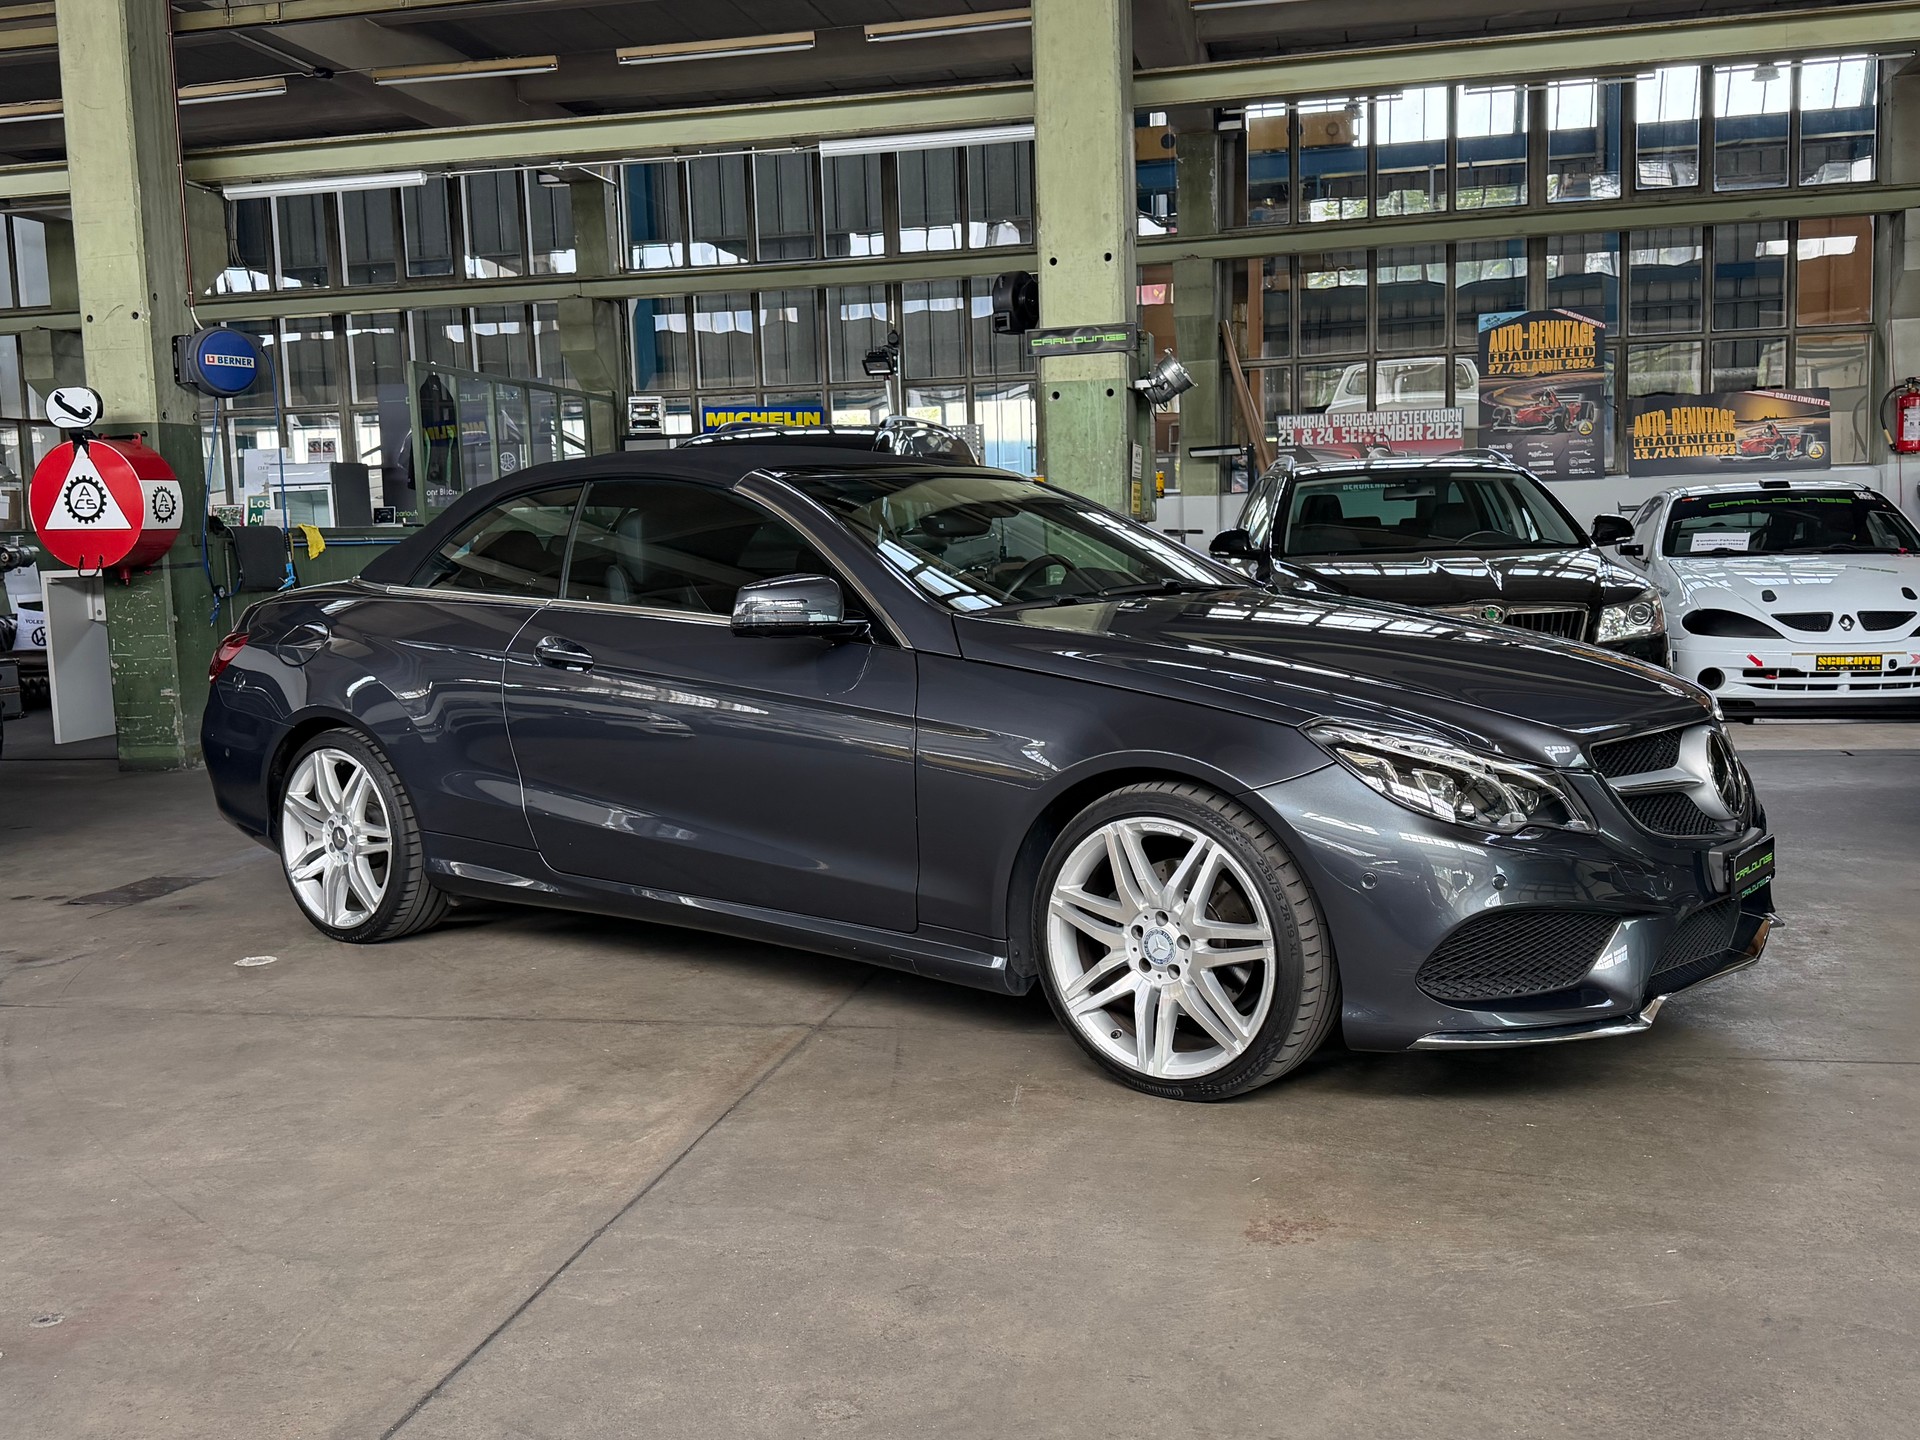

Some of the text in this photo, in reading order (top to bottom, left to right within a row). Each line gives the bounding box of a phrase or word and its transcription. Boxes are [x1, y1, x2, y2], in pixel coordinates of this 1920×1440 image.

[1031, 333, 1127, 347] CARLOUNGE
[1488, 320, 1596, 353] AUTO-RENNTAGE
[217, 356, 253, 367] BERNER
[1489, 347, 1594, 363] FRAUENFELD
[1565, 358, 1596, 369] 2024
[1775, 392, 1825, 405] GRATIS EINTRITT
[705, 411, 821, 427] MICHELIN
[1278, 408, 1463, 430] MEMORIAL BERGRENNEN STECKBORN
[1634, 406, 1736, 438] AUTO-RENNTAGE
[1278, 422, 1463, 447] 23. & 24. SEPTEMBER 2023
[1634, 432, 1735, 448] FRAUENFELD
[1705, 443, 1736, 456] 2023
[1708, 496, 1853, 509] CARLOUNGE
[1817, 655, 1882, 666] SCHROTH
[1735, 852, 1773, 882] CARLOUNGE
[1257, 859, 1298, 957] 235/35 ZR 19 XL
